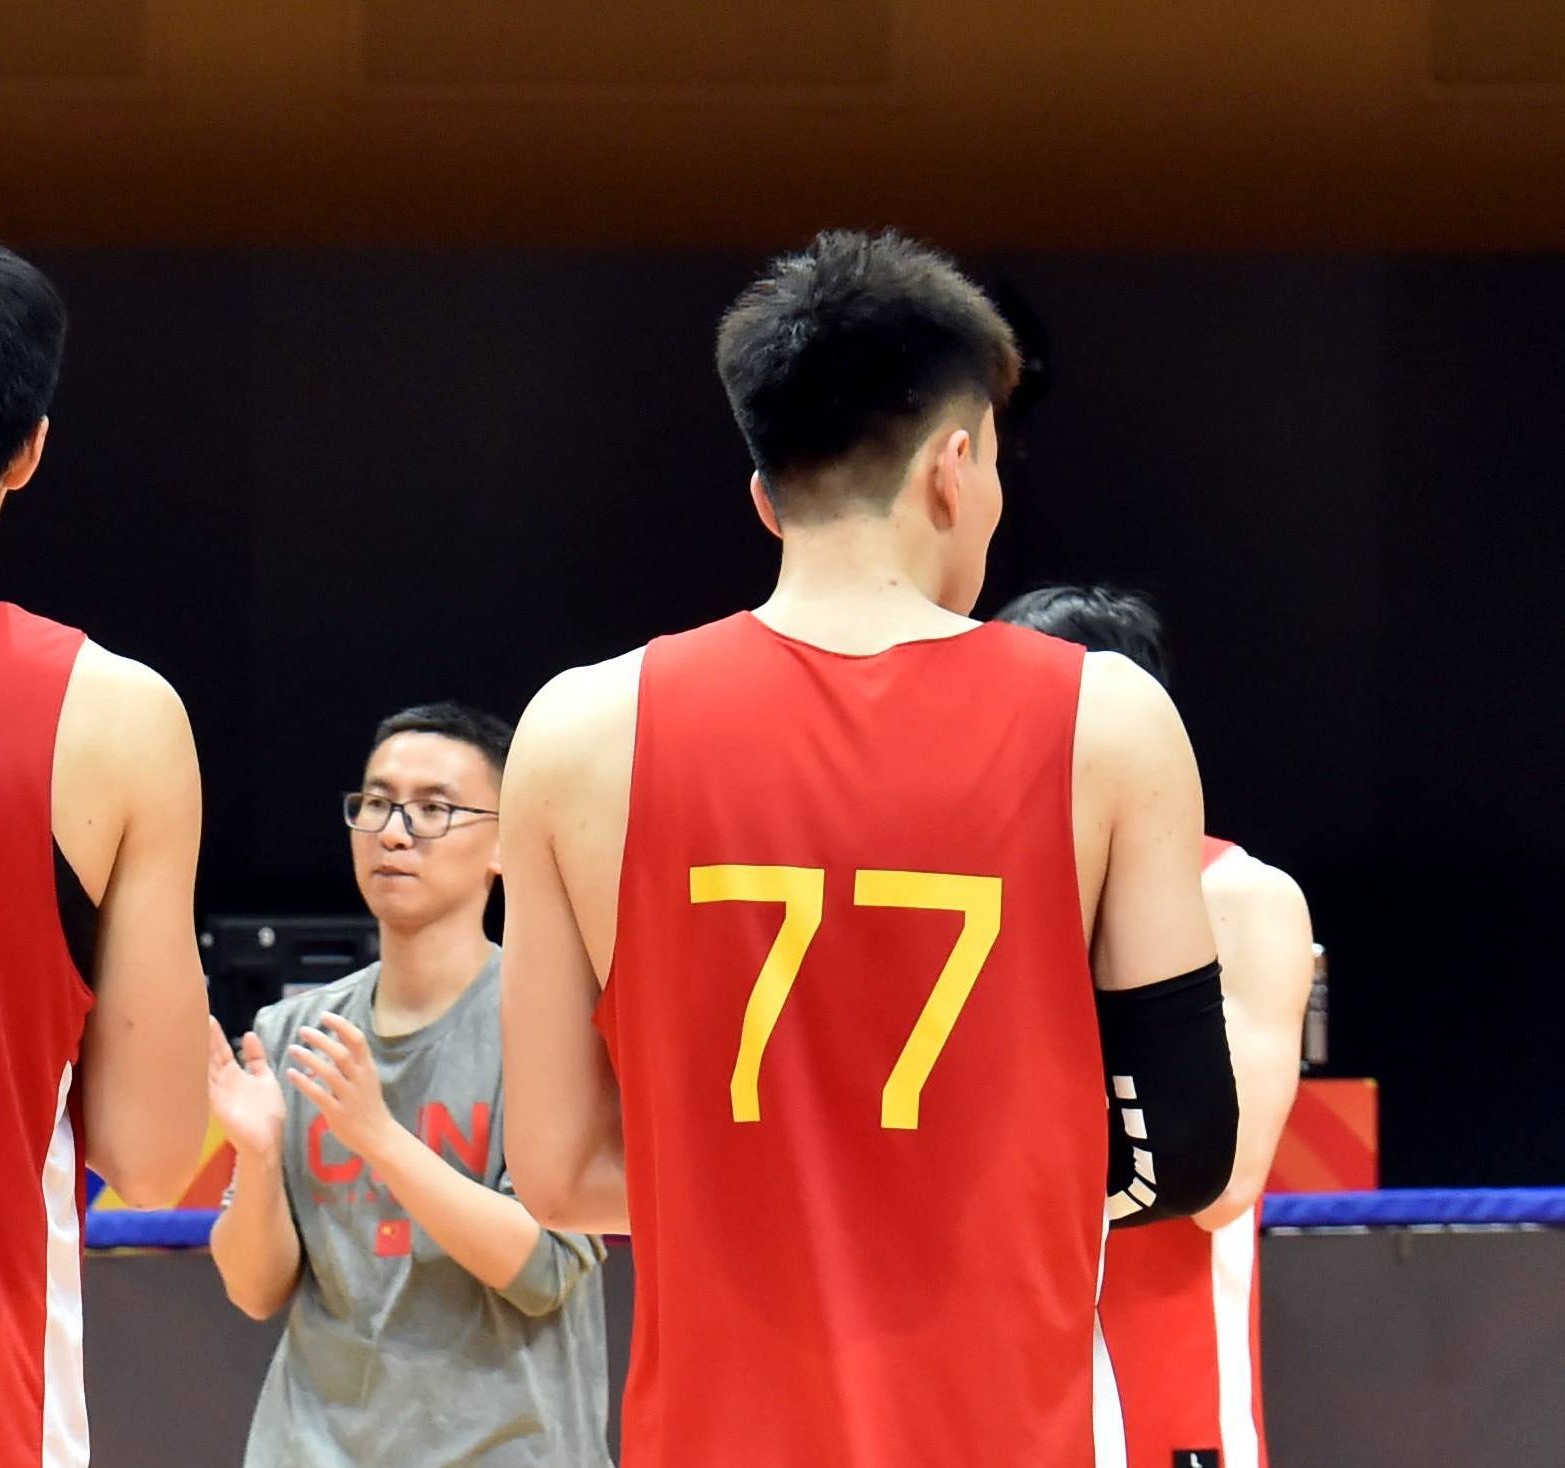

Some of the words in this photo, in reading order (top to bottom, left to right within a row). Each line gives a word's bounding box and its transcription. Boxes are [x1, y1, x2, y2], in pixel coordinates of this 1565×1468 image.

[689, 864, 1003, 1130] 77
[307, 1102, 490, 1184] CN
[1190, 1452, 1203, 1468] L
